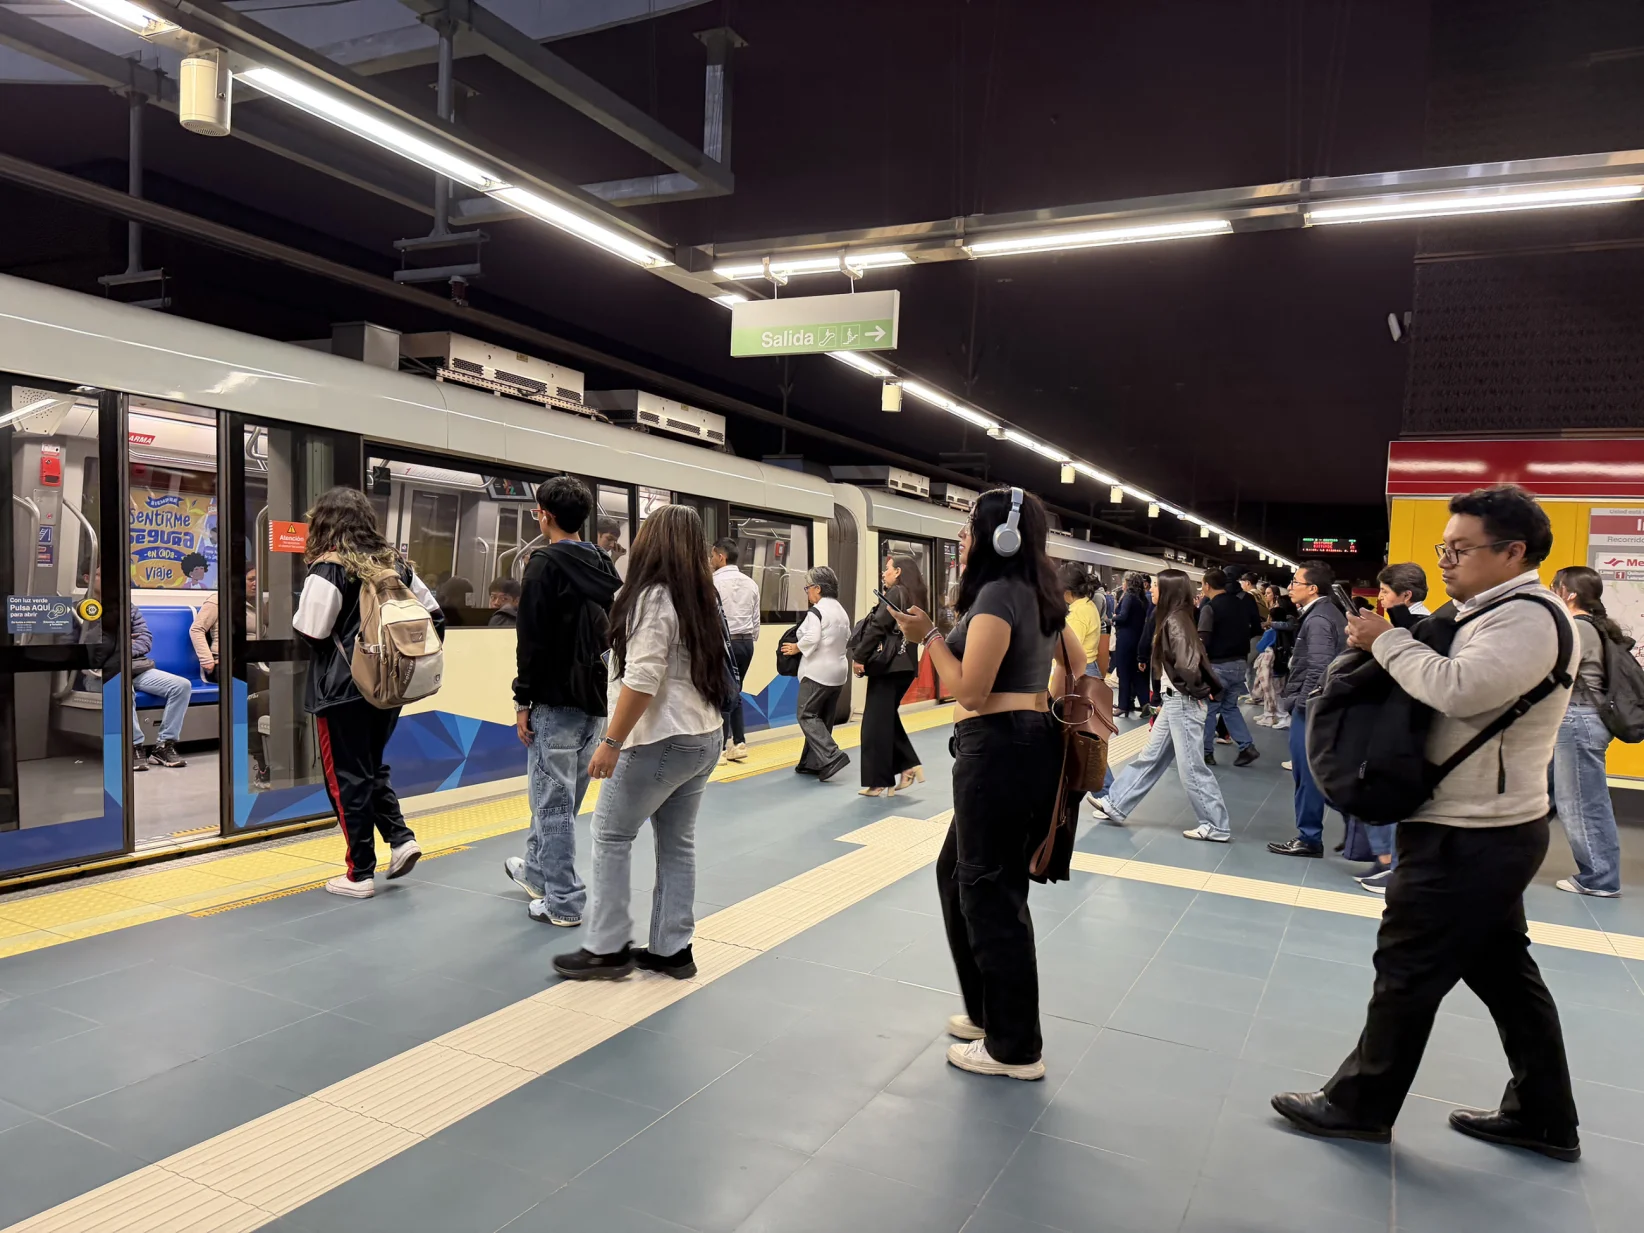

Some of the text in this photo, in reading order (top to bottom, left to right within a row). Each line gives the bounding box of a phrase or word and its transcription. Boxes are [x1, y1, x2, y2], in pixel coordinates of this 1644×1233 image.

[761, 330, 814, 348] Salida
[129, 435, 153, 444] ARMA
[31, 603, 50, 611] AQUÍ
